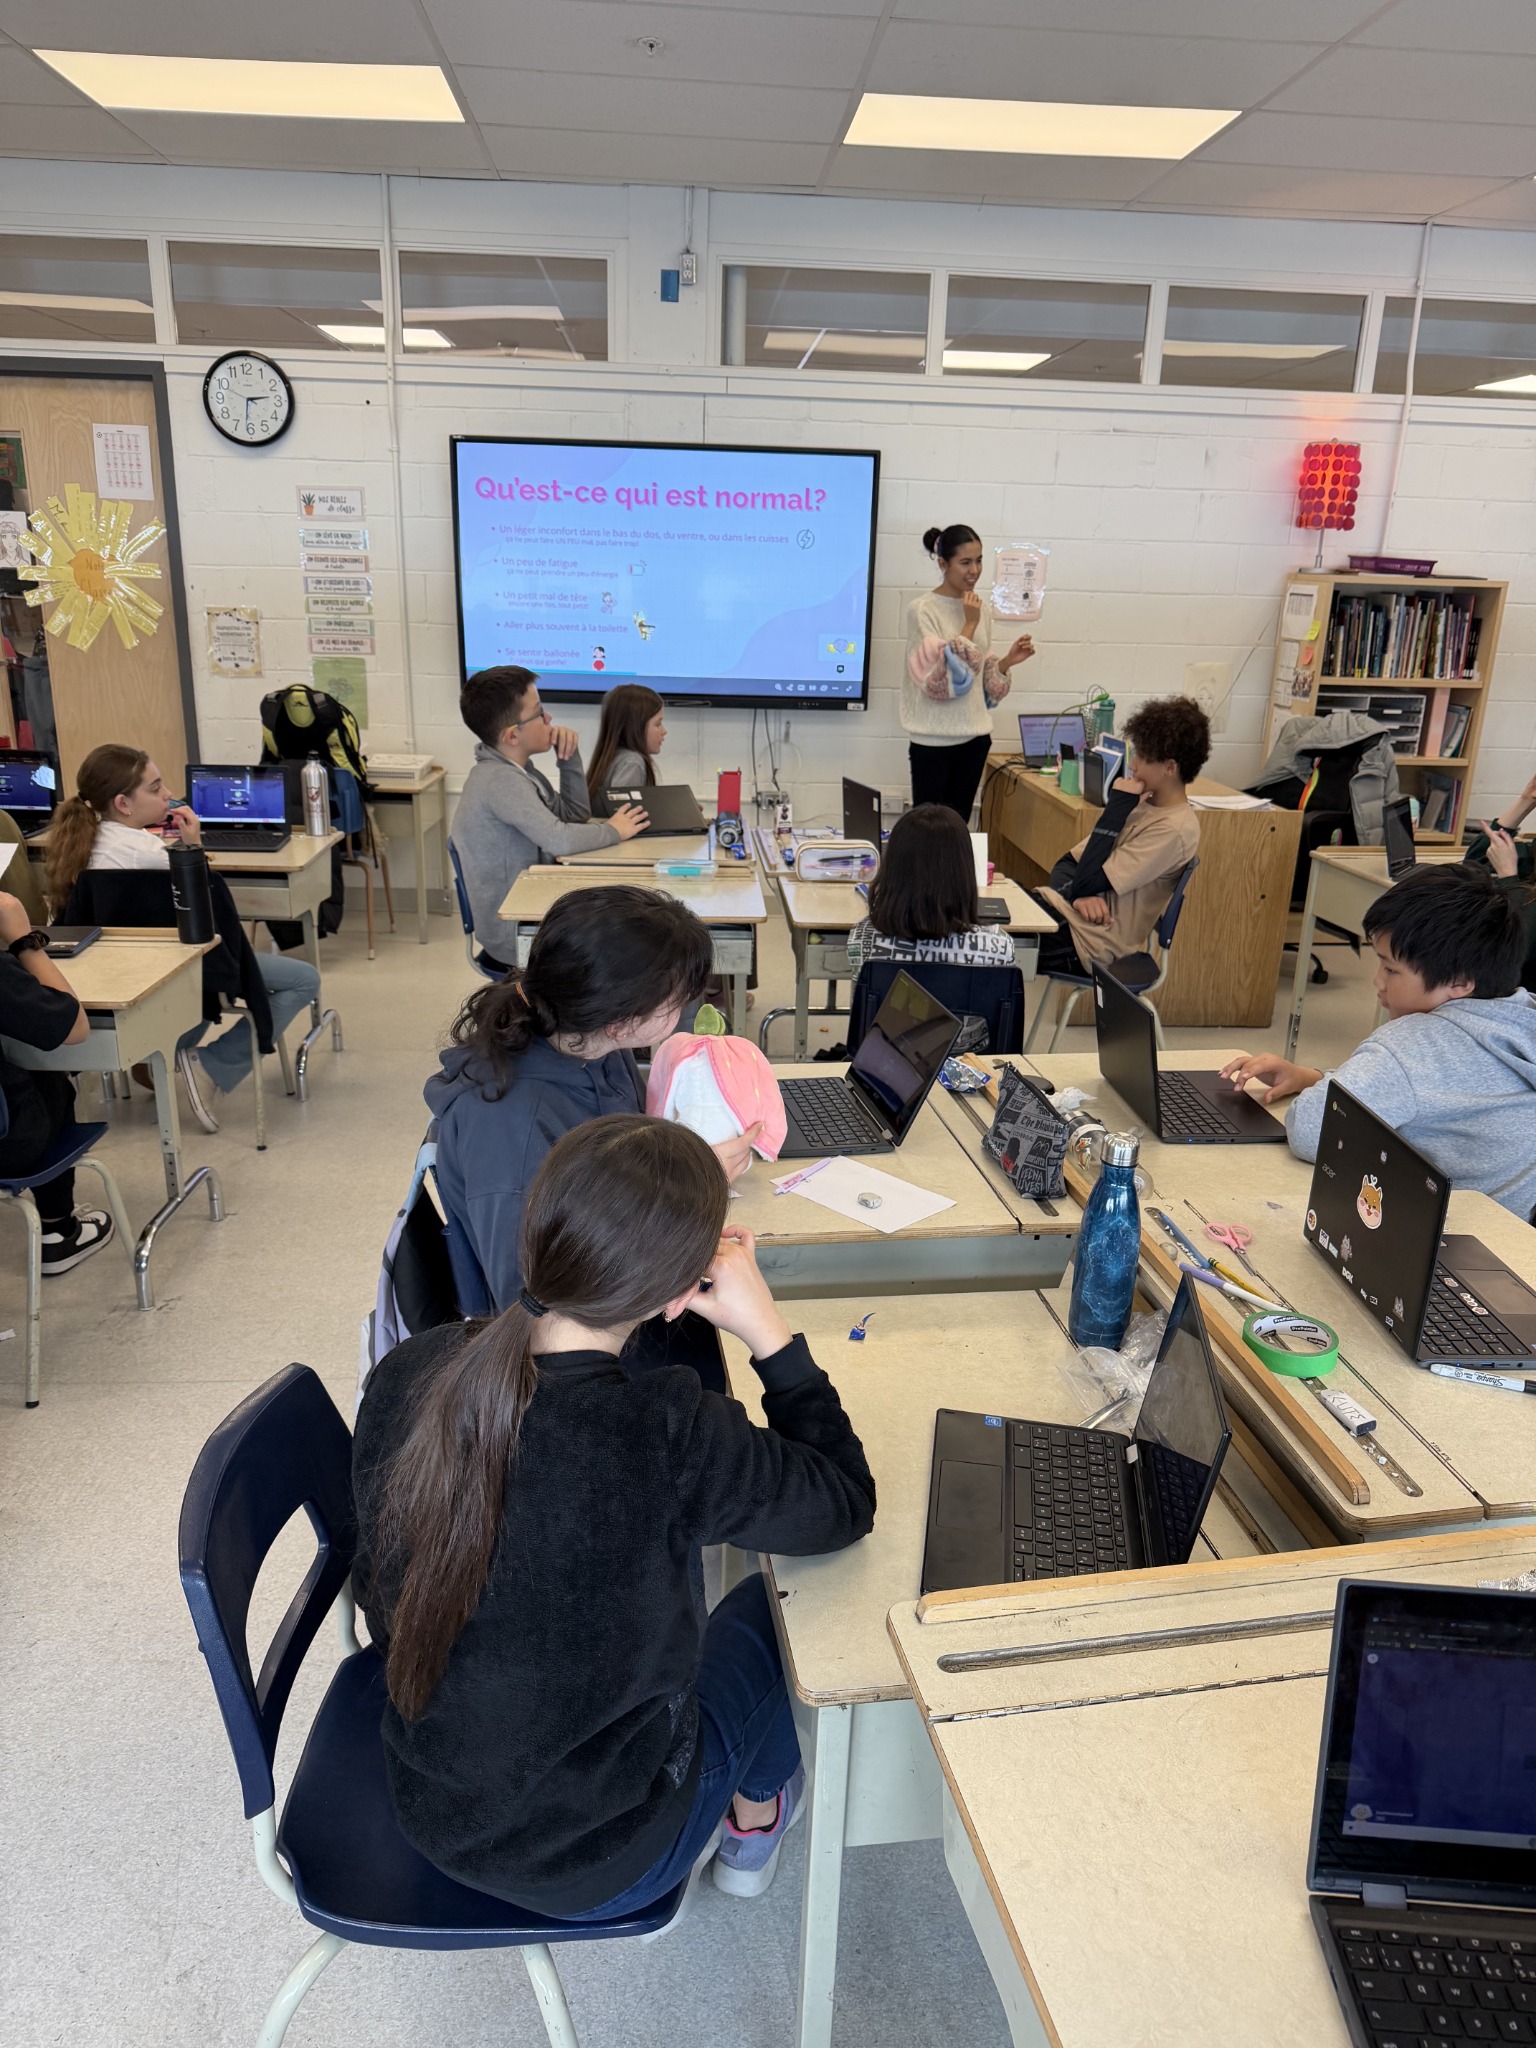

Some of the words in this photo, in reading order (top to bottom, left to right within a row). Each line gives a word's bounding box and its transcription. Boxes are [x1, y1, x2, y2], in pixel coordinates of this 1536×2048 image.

[227, 365, 237, 378] 11
[240, 363, 252, 375] 12
[258, 368, 263, 379] 1
[217, 377, 230, 390] 10
[269, 379, 277, 391] 2
[216, 391, 224, 404] 9
[274, 395, 282, 407] 3
[221, 407, 230, 419] 8
[270, 410, 279, 422] 4
[232, 419, 240, 431] 7
[247, 422, 255, 435] 6
[261, 420, 269, 432] 5
[475, 476, 608, 503] Qu'est-ce
[615, 481, 658, 511] qui
[665, 485, 708, 508] est
[715, 487, 827, 512] normal?
[500, 525, 513, 534] Un
[514, 525, 536, 536] léger
[538, 526, 578, 536] inconfort
[580, 527, 601, 537] dans
[603, 528, 611, 537] le
[612, 528, 628, 538] bas
[630, 529, 641, 538] du
[643, 530, 661, 540] dos,
[663, 530, 675, 540] du
[677, 532, 707, 542] ventre,
[709, 534, 720, 542] ou
[722, 532, 743, 543] dans
[744, 533, 757, 543] les
[758, 534, 789, 544] cuisses
[501, 557, 515, 566] Un
[516, 559, 534, 568] peu
[535, 558, 547, 566] de
[548, 558, 578, 569] fatigue
[503, 591, 516, 600] Un
[518, 592, 538, 601] petit
[558, 593, 569, 601] de
[571, 594, 588, 602] tête
[504, 621, 523, 629] Aller
[526, 622, 544, 631] plus
[546, 624, 580, 632] souvent
[581, 623, 588, 632] à
[589, 624, 596, 632] la
[598, 624, 628, 633] toilette
[505, 648, 517, 656] Se
[518, 648, 542, 657] sentir
[544, 649, 581, 658] ballonée
[1322, 1163, 1337, 1179] acer
[1342, 1266, 1354, 1285] DGK
[1474, 1371, 1507, 1387] Sharpie
[1417, 1984, 1427, 1995] q
[1450, 1987, 1461, 1996] w
[1486, 1990, 1495, 1999] e
[1438, 2016, 1446, 2024] a
[1474, 2019, 1482, 2028] s
[1508, 2020, 1518, 2030] d
